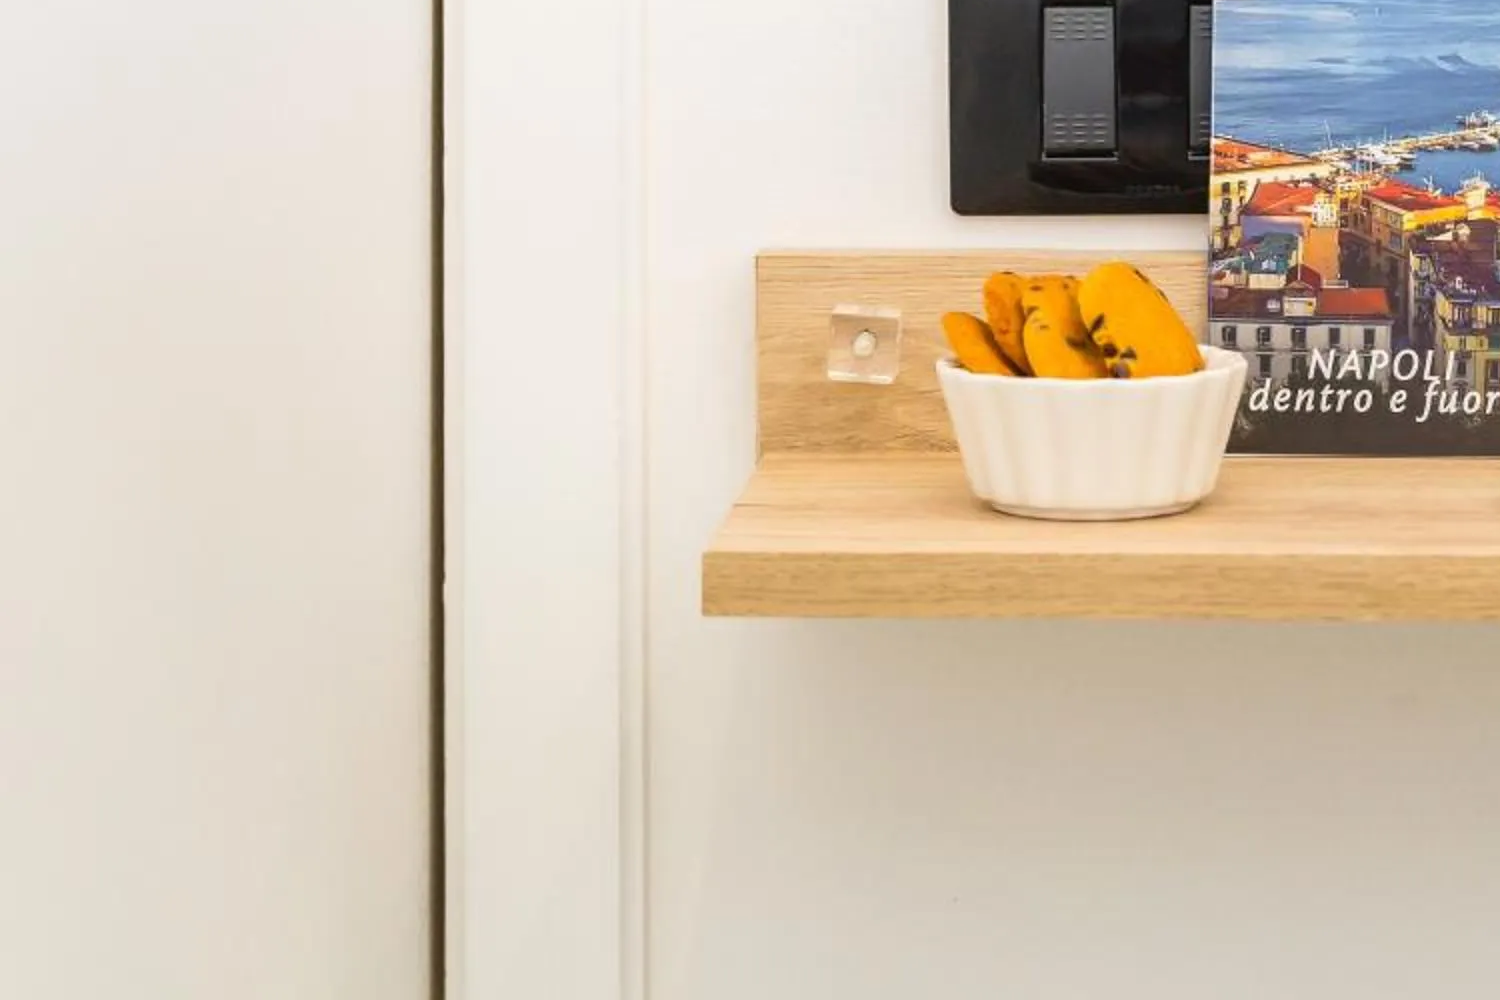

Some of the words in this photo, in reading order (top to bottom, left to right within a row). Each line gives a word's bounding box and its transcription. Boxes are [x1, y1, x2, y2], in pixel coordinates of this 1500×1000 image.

[1307, 348, 1456, 382] NAPOLI
[1249, 377, 1374, 413] dentro
[1389, 388, 1408, 414] e
